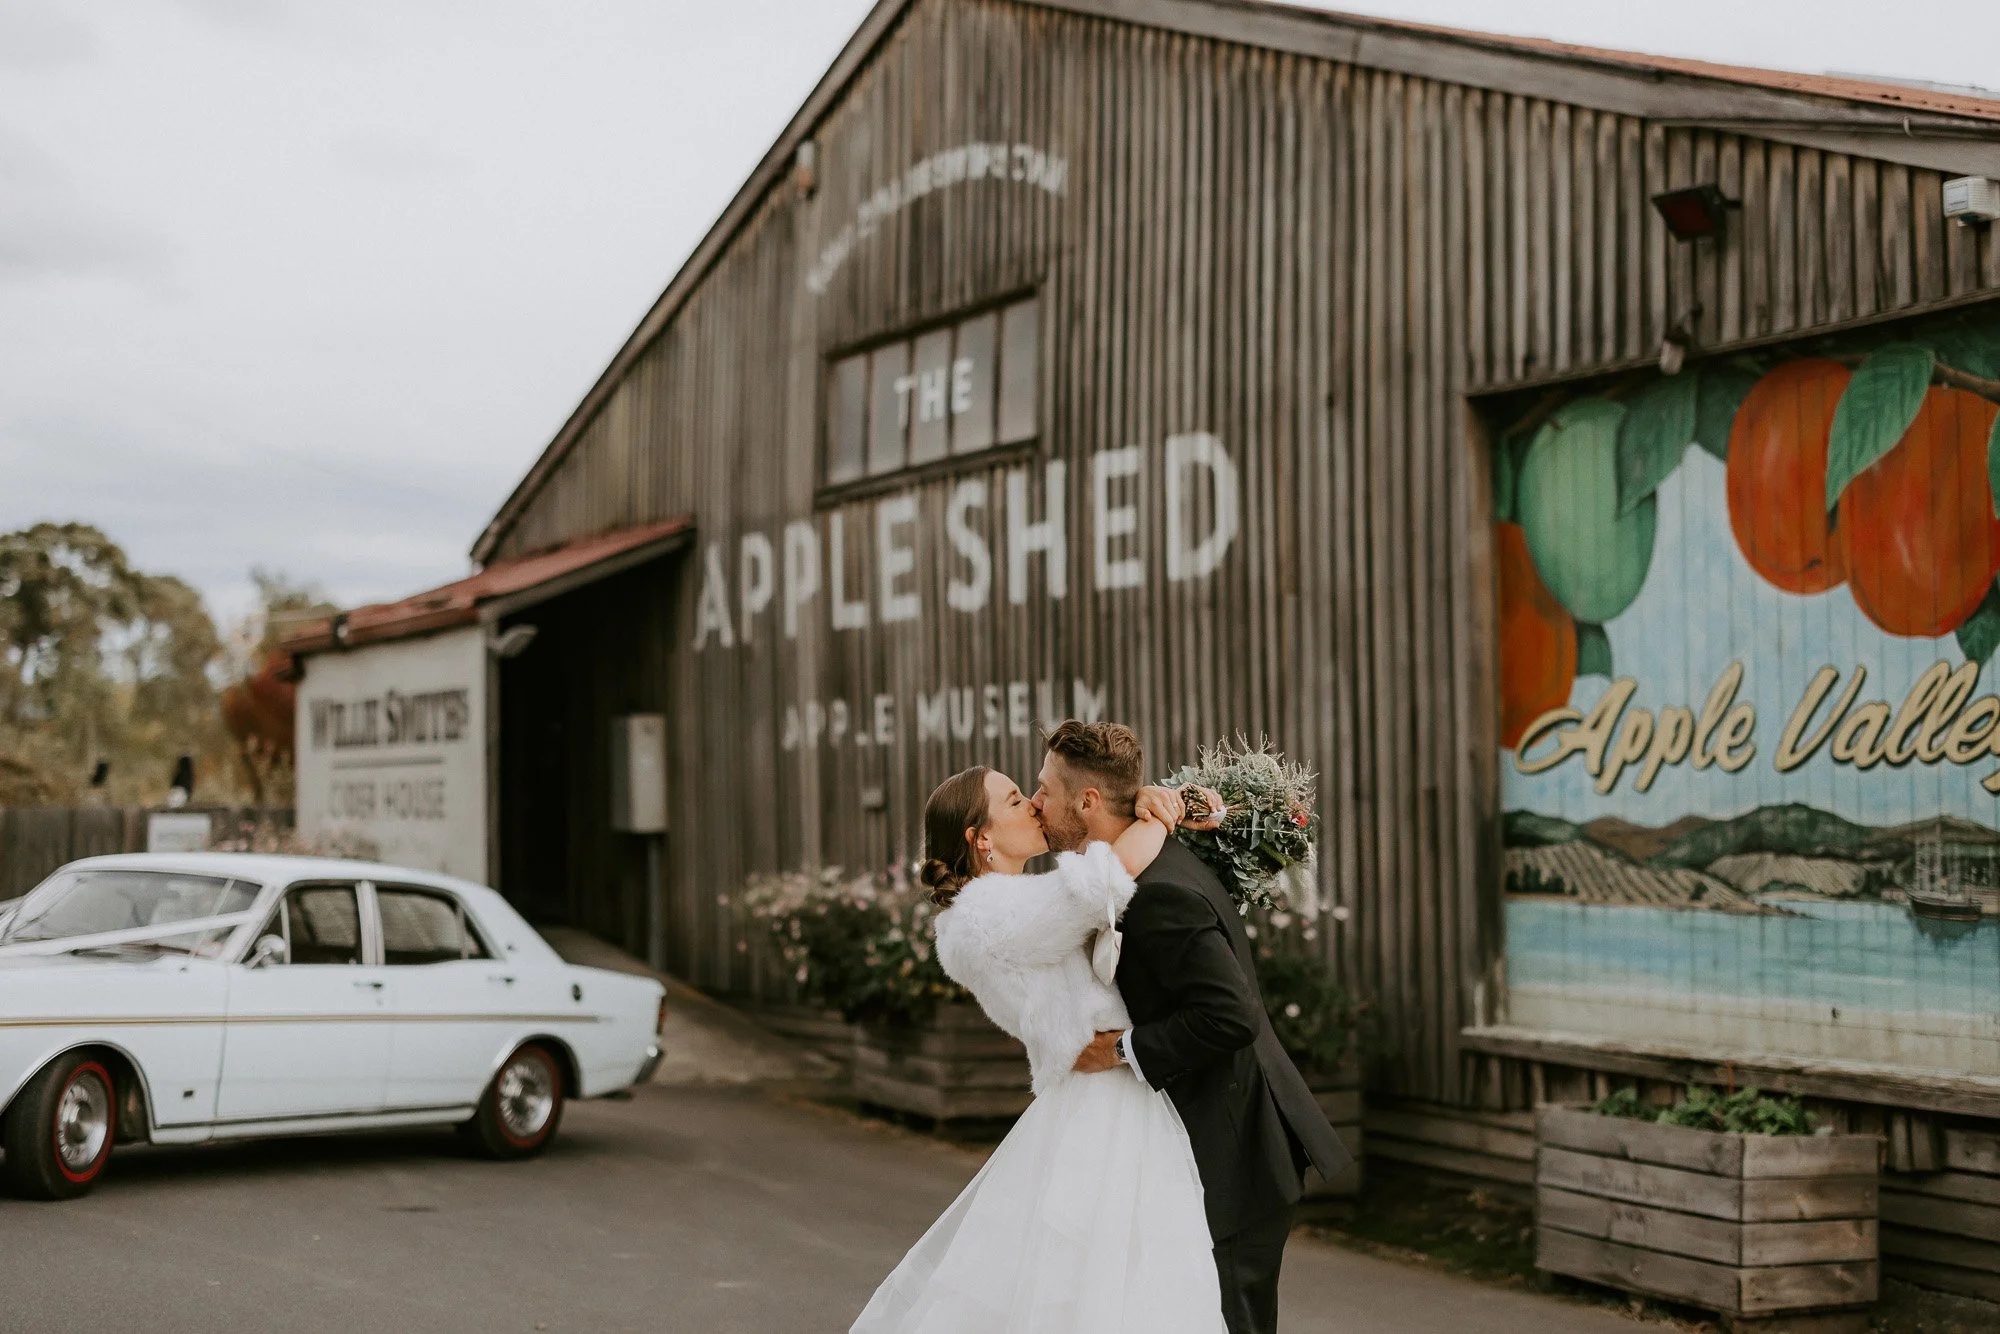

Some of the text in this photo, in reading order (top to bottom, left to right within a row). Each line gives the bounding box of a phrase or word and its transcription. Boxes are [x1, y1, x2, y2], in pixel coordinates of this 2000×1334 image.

[892, 358, 974, 429] THE
[693, 430, 1238, 651] APPLE SHED
[1515, 660, 2000, 795] Apple Valle
